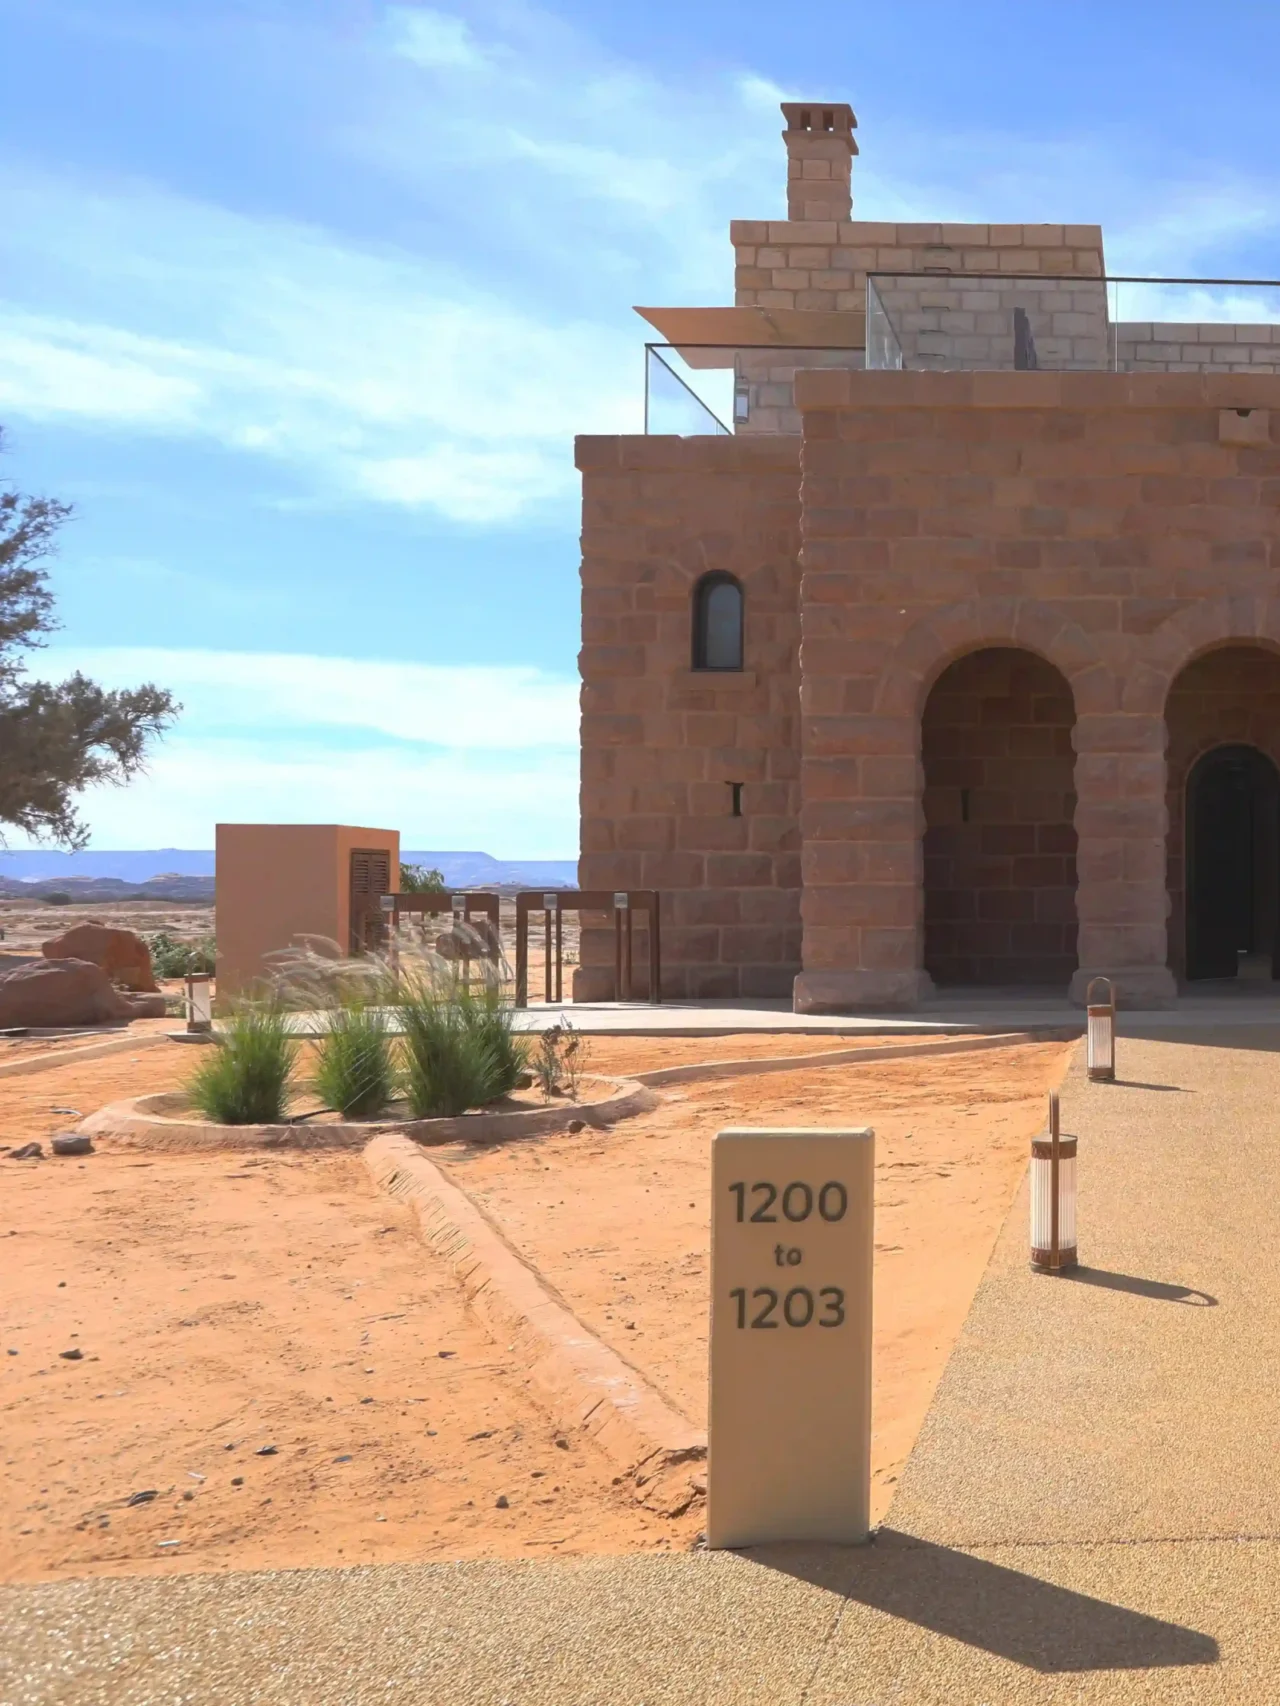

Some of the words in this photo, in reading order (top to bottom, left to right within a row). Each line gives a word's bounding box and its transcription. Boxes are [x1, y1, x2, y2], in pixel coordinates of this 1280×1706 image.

[728, 1180, 848, 1223] 1200
[774, 1244, 802, 1267] to
[729, 1286, 846, 1329] 1203
